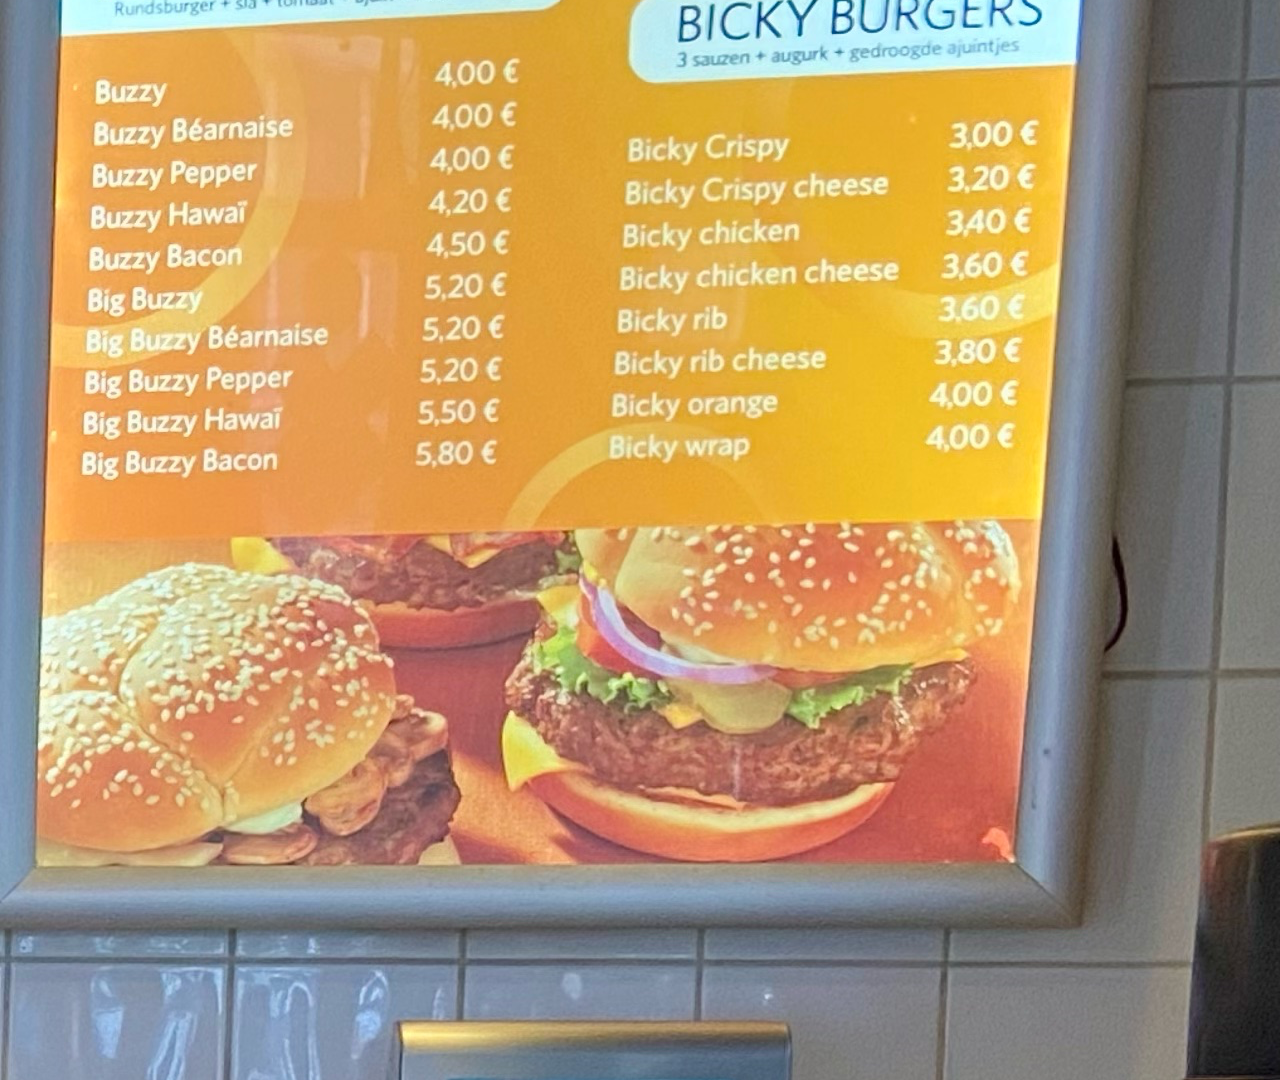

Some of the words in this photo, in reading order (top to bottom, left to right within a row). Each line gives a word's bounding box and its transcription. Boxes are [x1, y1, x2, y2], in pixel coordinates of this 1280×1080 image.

[115, 1, 216, 17] Rundsburger
[677, 0, 816, 43] BICKY
[832, 0, 1043, 35] BURGERS
[676, 51, 688, 68] 3
[693, 54, 751, 67] sauzen
[771, 47, 830, 66] augurk
[849, 41, 943, 62] gedroogde
[947, 38, 1020, 57] ajuintjes
[96, 79, 166, 106] Buzzy
[94, 121, 165, 148] Buzzy
[173, 116, 292, 141] Béarnaise
[628, 137, 697, 164] Bicky
[705, 134, 789, 160] Crispy
[93, 163, 163, 190] Buzzy
[171, 161, 256, 187] Pepper
[625, 180, 694, 207] Bicky
[703, 178, 786, 203] Crispy
[794, 173, 888, 198] cheese
[91, 205, 161, 232] Buzzy
[169, 202, 246, 225] Hawaï
[623, 223, 691, 250] Bicky
[700, 220, 800, 244] chicken
[89, 247, 160, 273] Buzzy
[167, 244, 241, 267] Bacon
[620, 266, 688, 293] Bicky
[697, 263, 796, 286] chicken
[805, 258, 899, 283] cheese
[88, 288, 124, 314] Big
[132, 287, 202, 312] Buzzy
[618, 309, 685, 335] Bicky
[694, 306, 727, 329] rib
[86, 329, 122, 356] Big
[131, 329, 199, 354] Buzzy
[209, 325, 328, 348] Béarnaise
[615, 351, 682, 378] Bicky
[691, 349, 724, 371] rib
[733, 348, 826, 370] cheese
[85, 371, 121, 398] Big
[129, 370, 198, 395] Buzzy
[207, 367, 292, 392] Pepper
[612, 393, 679, 420] Bicky
[688, 395, 778, 418] orange
[83, 411, 120, 438] Big
[128, 411, 197, 436] Buzzy
[205, 408, 281, 430] Hawaï
[610, 435, 677, 463] Bicky
[685, 438, 750, 460] wrap
[925, 425, 990, 452] 4,00
[82, 452, 118, 480] Big
[126, 451, 196, 477] Buzzy
[203, 448, 277, 471] Bacon
